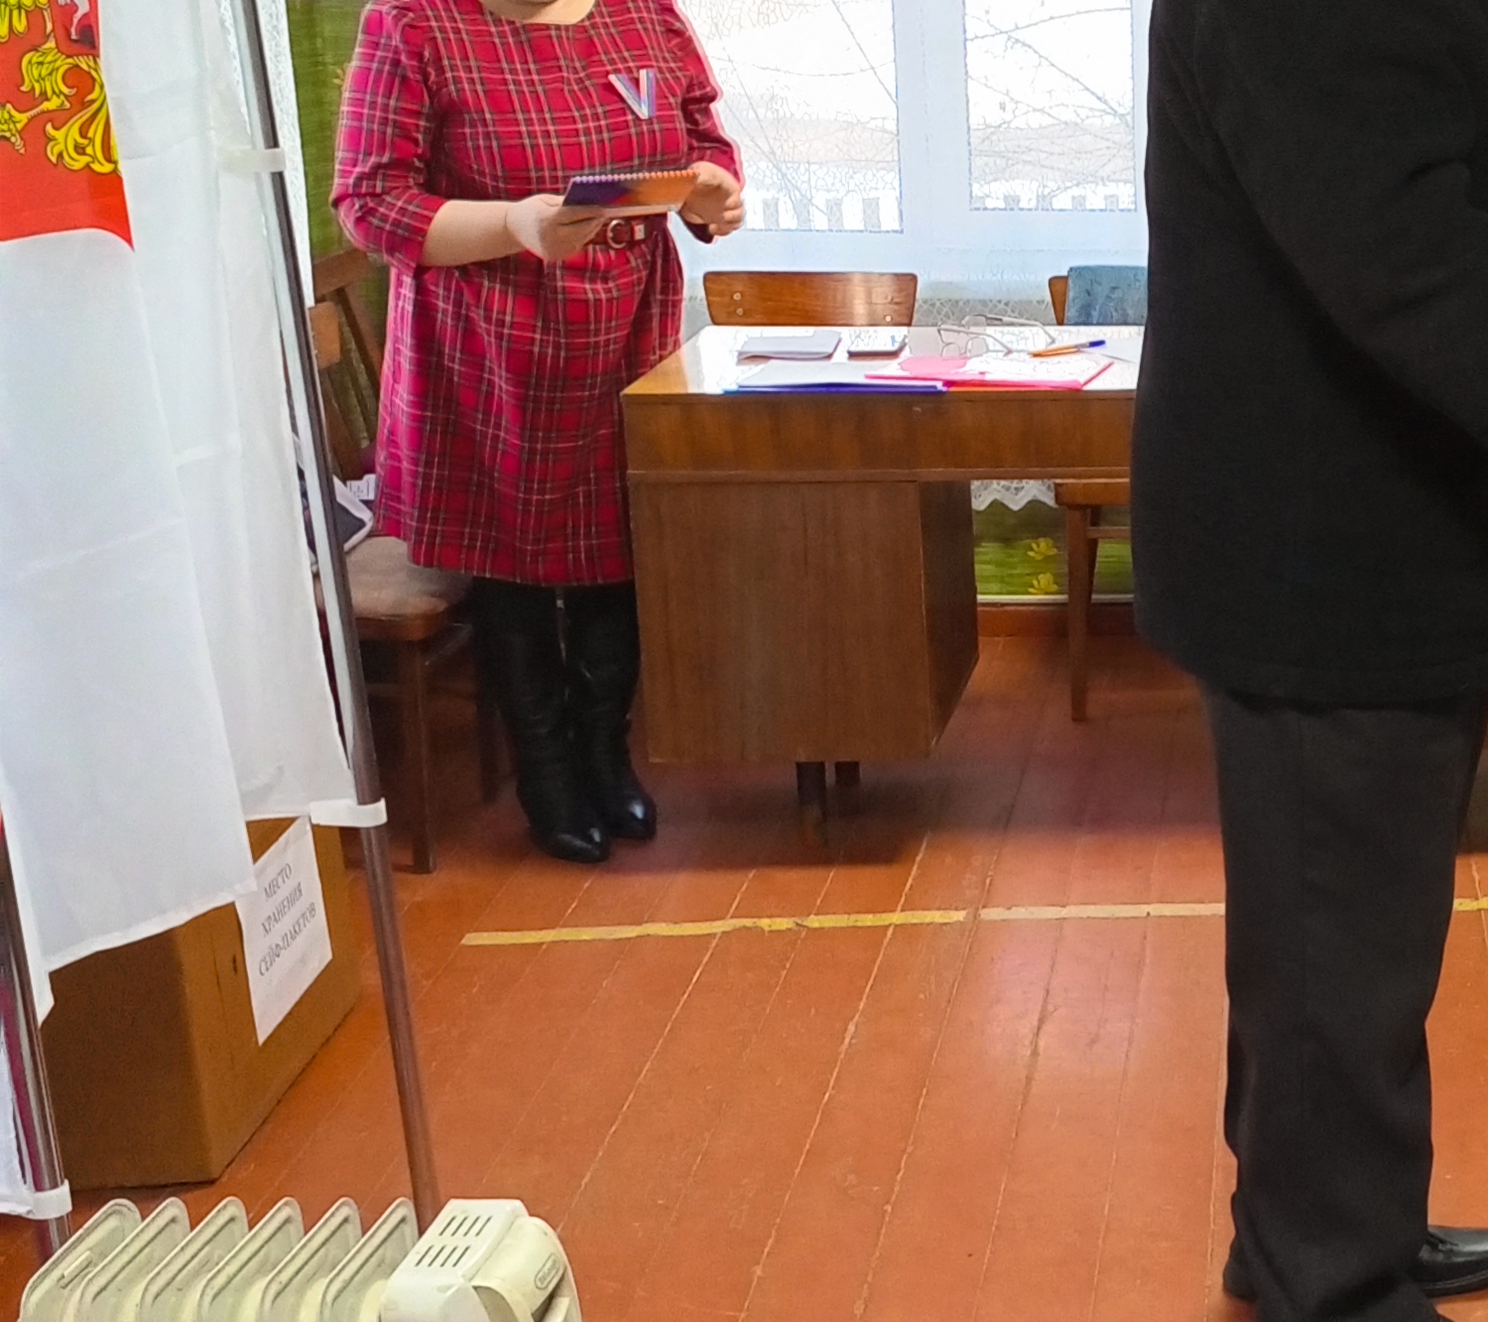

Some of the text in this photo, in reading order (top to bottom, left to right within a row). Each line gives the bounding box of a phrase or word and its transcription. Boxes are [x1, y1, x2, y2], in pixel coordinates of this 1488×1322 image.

[261, 881, 303, 938] ХРАНЕНИЯ
[264, 862, 292, 902] МЕСТО
[259, 901, 317, 977] СЕЙФ-ПАКЕТОВ
